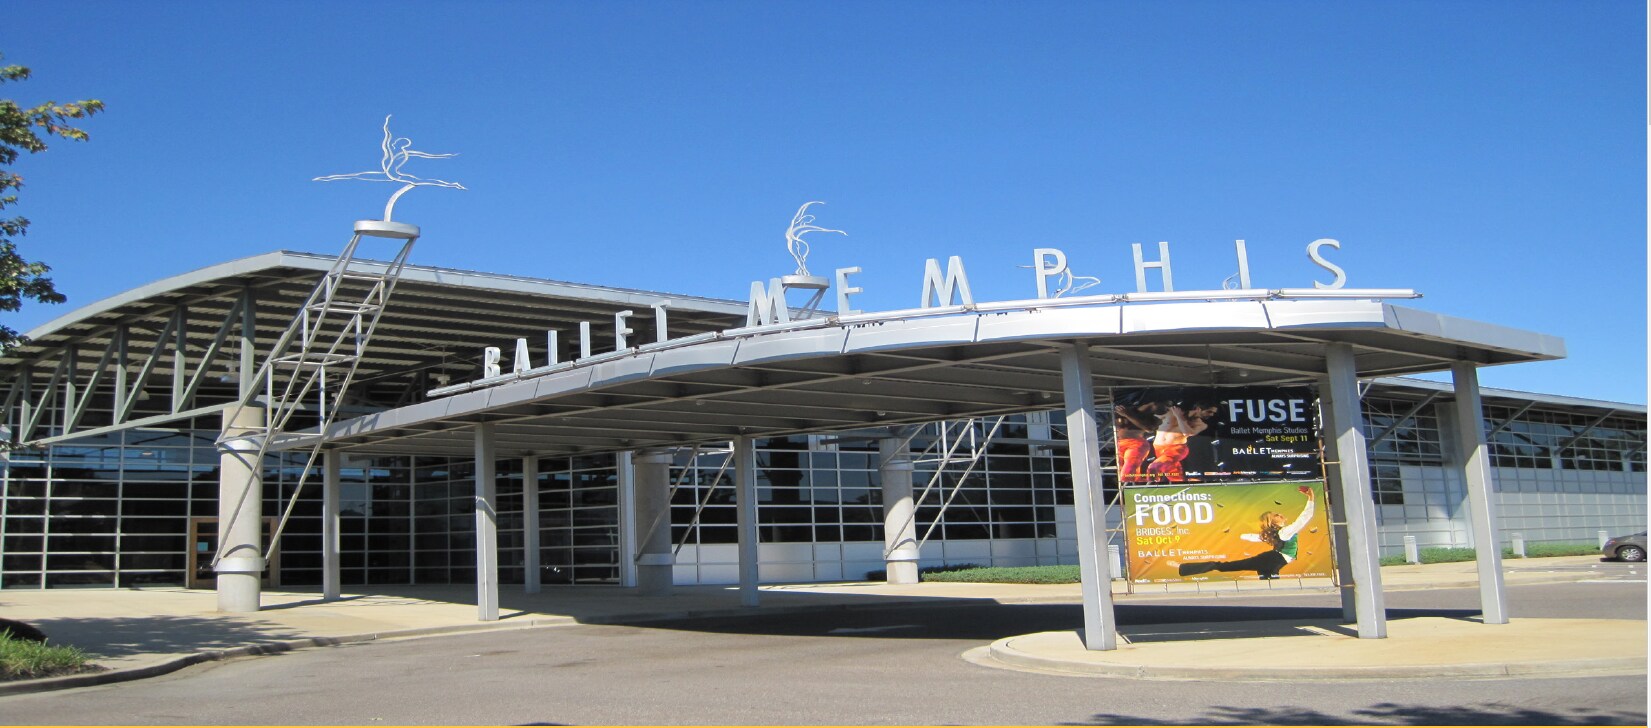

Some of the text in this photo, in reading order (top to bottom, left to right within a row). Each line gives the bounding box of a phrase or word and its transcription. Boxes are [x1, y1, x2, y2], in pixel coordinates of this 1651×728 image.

[746, 238, 1346, 327] MEMPHIS
[1228, 399, 1306, 422] FUSE
[1252, 427, 1282, 435] Memphis
[1232, 447, 1271, 455] BALLET
[1134, 492, 1212, 503] Connections:
[1135, 502, 1213, 526] FOOD
[1136, 535, 1181, 545] Sat Oct 9
[1138, 549, 1182, 558] BALLET
